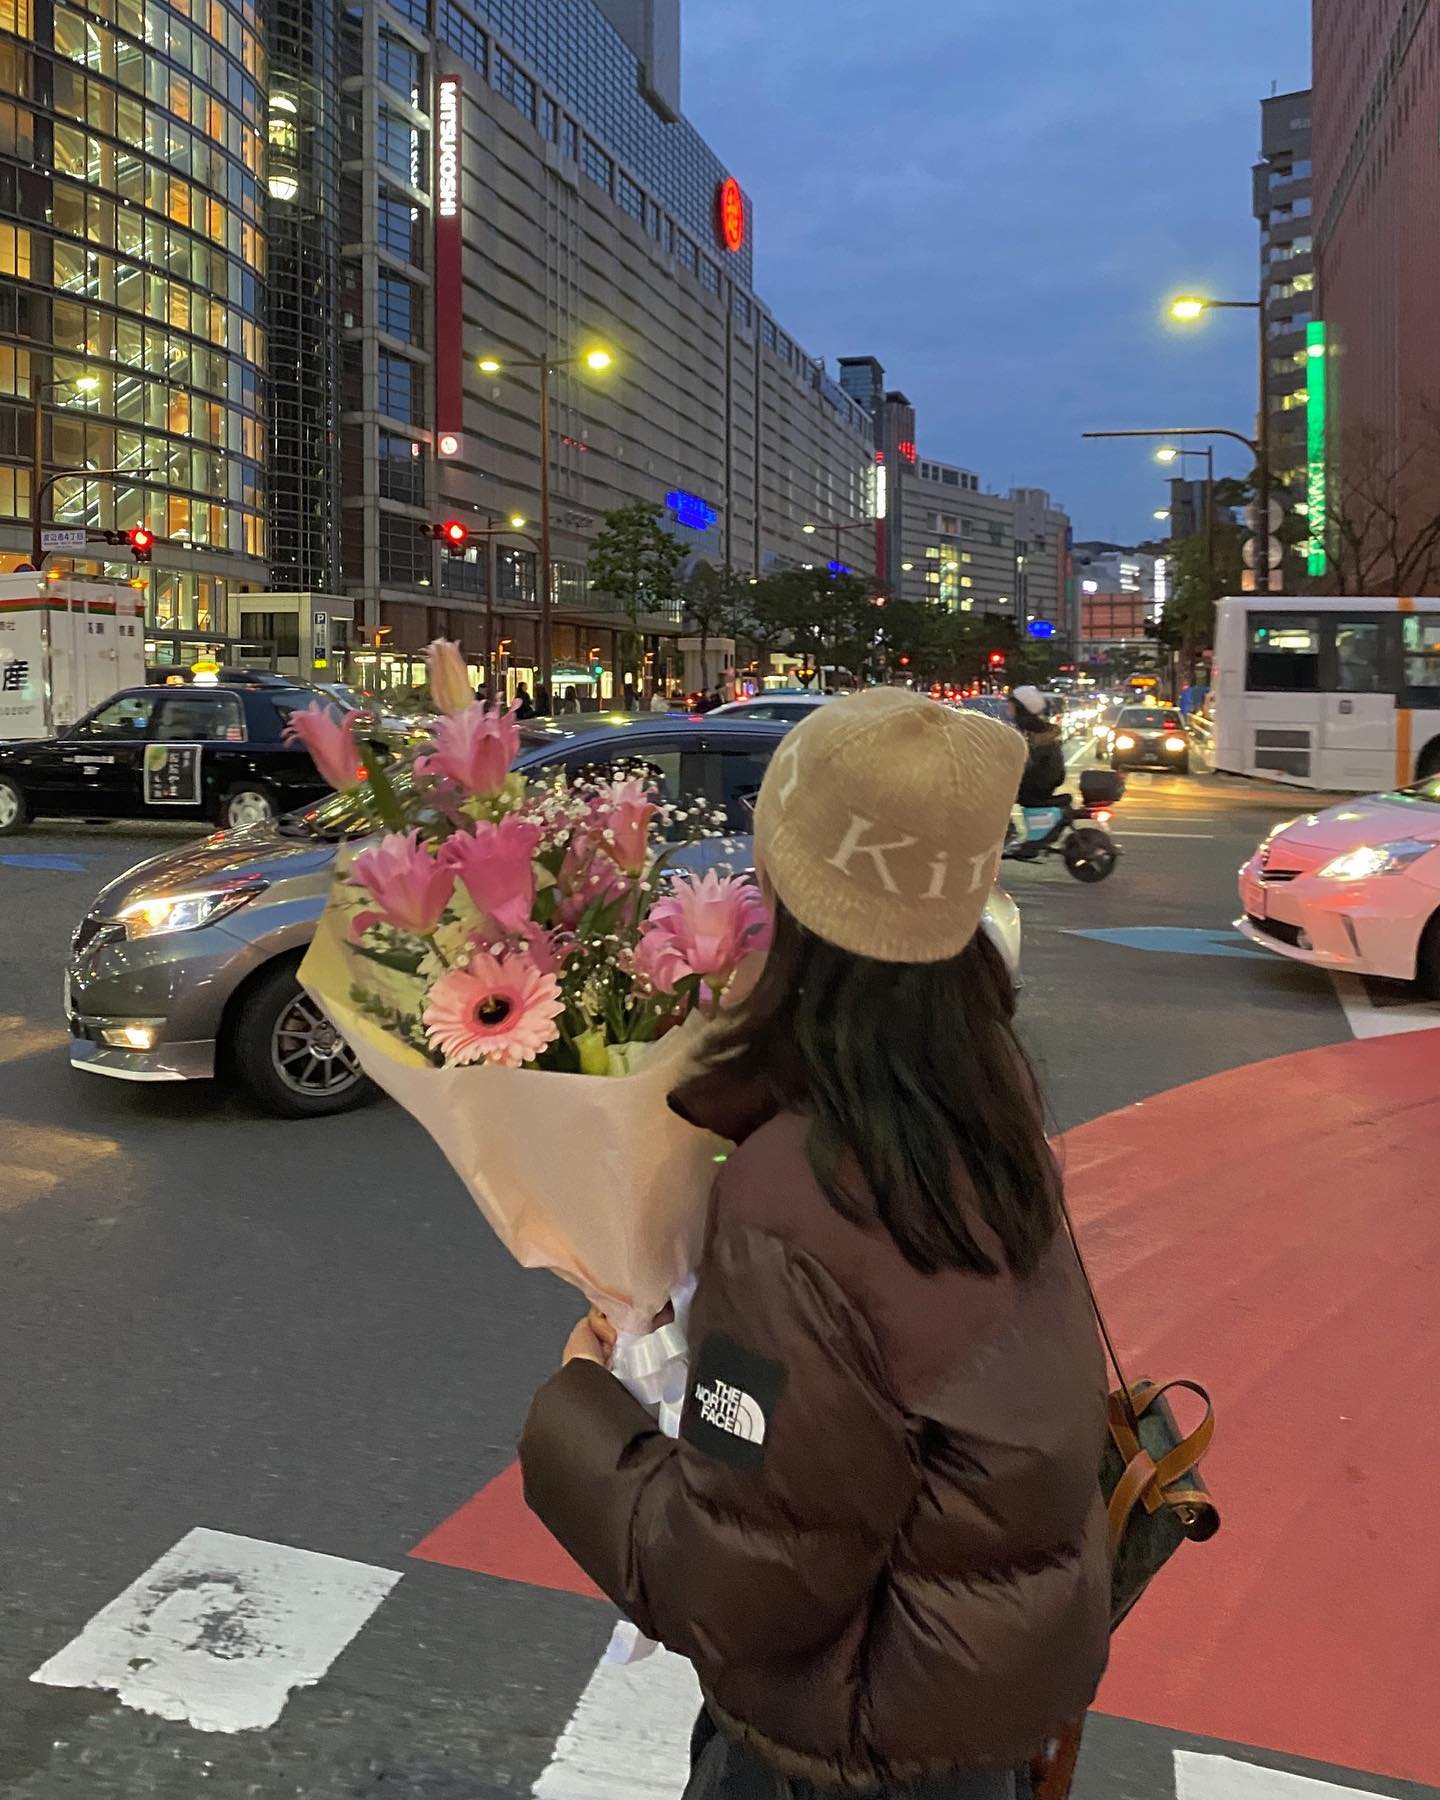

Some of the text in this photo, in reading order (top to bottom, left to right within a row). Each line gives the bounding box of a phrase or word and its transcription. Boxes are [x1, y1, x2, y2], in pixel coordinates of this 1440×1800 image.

[439, 82, 456, 216] MITSUKOSHI
[317, 614, 324, 624] P
[2, 659, 29, 691] 産
[695, 1383, 740, 1419] NORTH
[715, 1379, 742, 1402] THE
[701, 1404, 735, 1433] FACE
